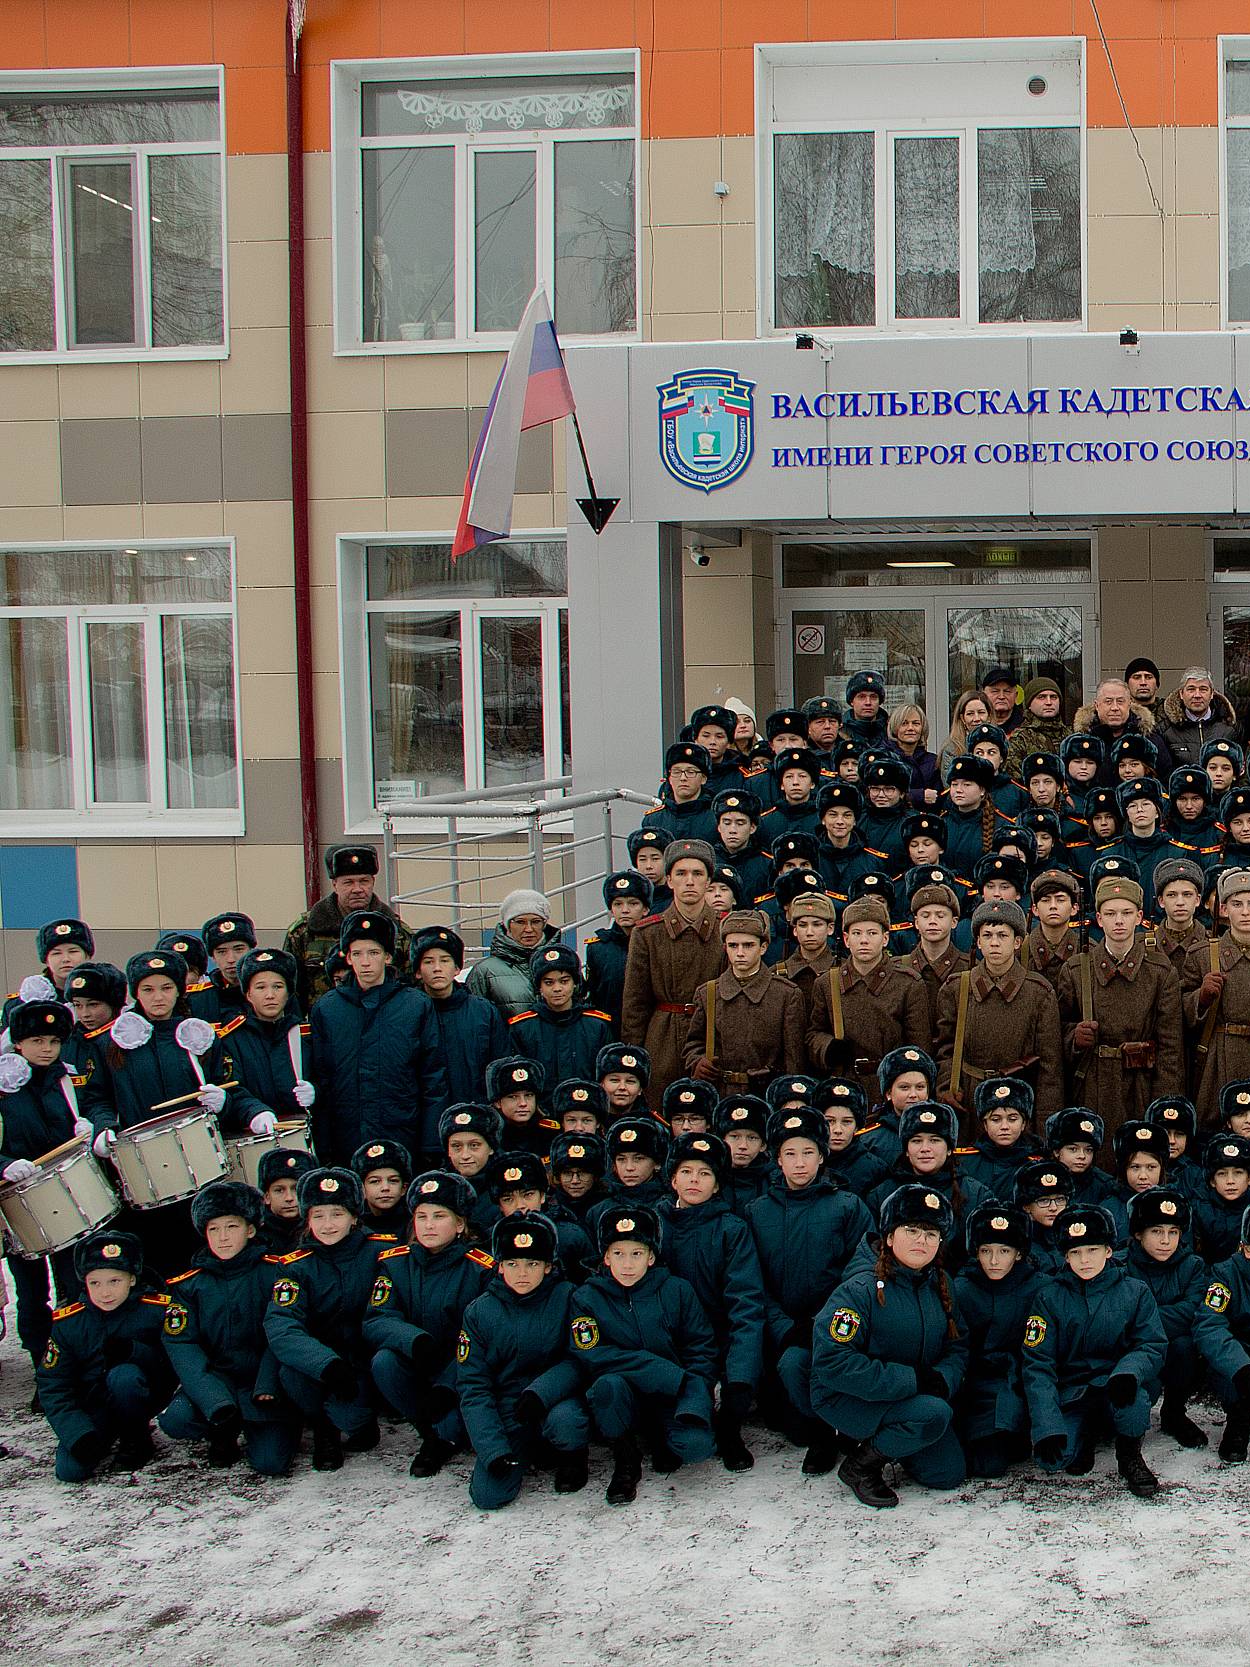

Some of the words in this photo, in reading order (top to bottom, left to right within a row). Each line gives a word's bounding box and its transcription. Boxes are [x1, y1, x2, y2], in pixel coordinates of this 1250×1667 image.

[770, 388, 1048, 419] ВАСИЛЬЕВСКАЯ
[772, 445, 871, 468] ИМЕНИ
[879, 443, 967, 466] ГЕРОЯ
[973, 441, 1160, 464] СОВЕТСКОГО
